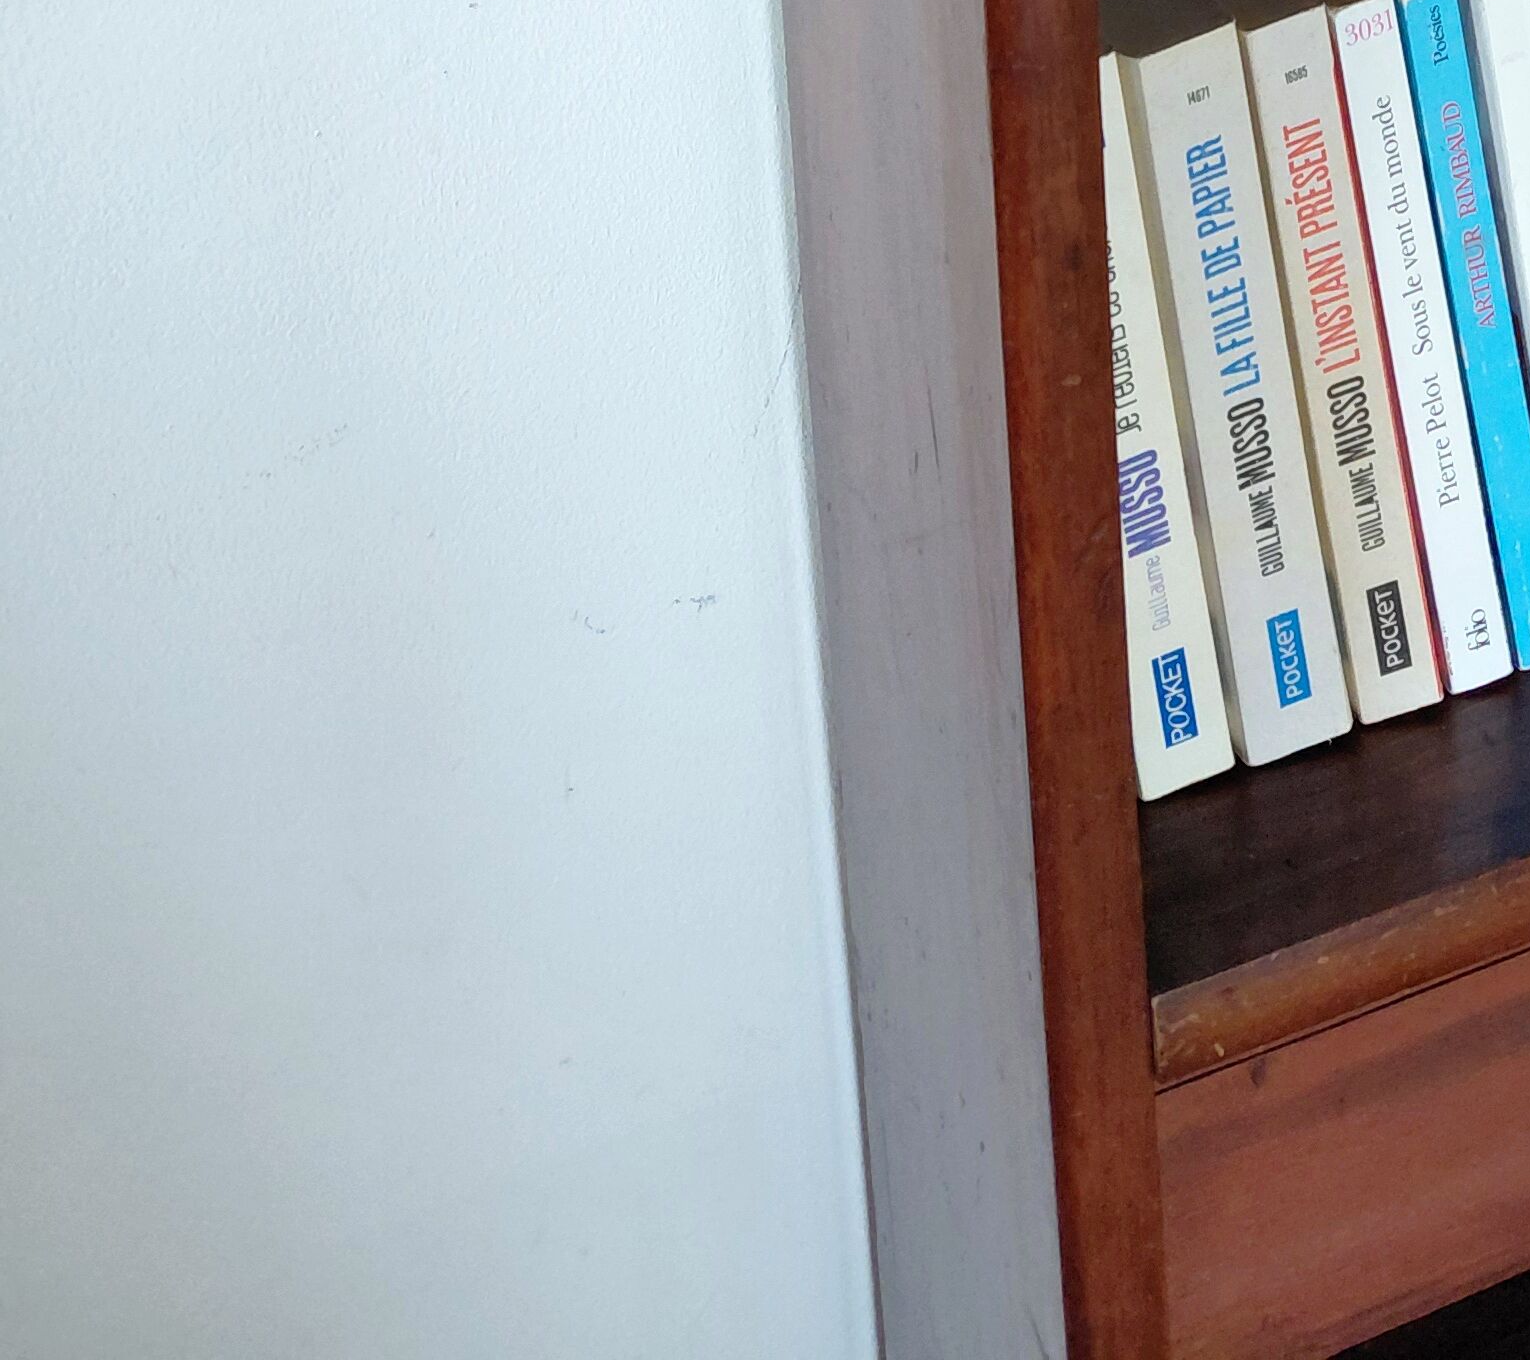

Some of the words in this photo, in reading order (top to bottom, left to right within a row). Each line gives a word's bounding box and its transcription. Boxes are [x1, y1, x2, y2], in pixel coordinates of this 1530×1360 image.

[1345, 9, 1394, 47] 3031
[1428, 4, 1449, 67] Poésies
[1371, 94, 1403, 176] monde
[1443, 101, 1477, 218] RIMBAUD
[1186, 134, 1236, 239] PAPIER
[1283, 118, 1338, 240] PRÉSENT
[1388, 182, 1409, 214] du
[1201, 235, 1242, 280] DE
[1396, 218, 1417, 270] vent
[1463, 224, 1496, 327] ARTHUR
[1207, 277, 1254, 356] FILLE
[1303, 240, 1361, 374] L'INSTANT
[1403, 273, 1424, 298] le
[1411, 299, 1434, 355] Sous
[1220, 351, 1261, 397] LA
[1422, 372, 1446, 435] Pelot
[1227, 397, 1276, 492] MUSSO
[1326, 374, 1377, 467] MUSSO
[1117, 449, 1172, 559] MUSSO
[1349, 462, 1385, 552] GUILLAUME
[1438, 437, 1460, 509] Pierre
[1249, 485, 1285, 577] GUILLAUME
[1146, 554, 1171, 632] Guillaume
[1464, 608, 1491, 652] folio
[1160, 654, 1192, 745] POCKET
